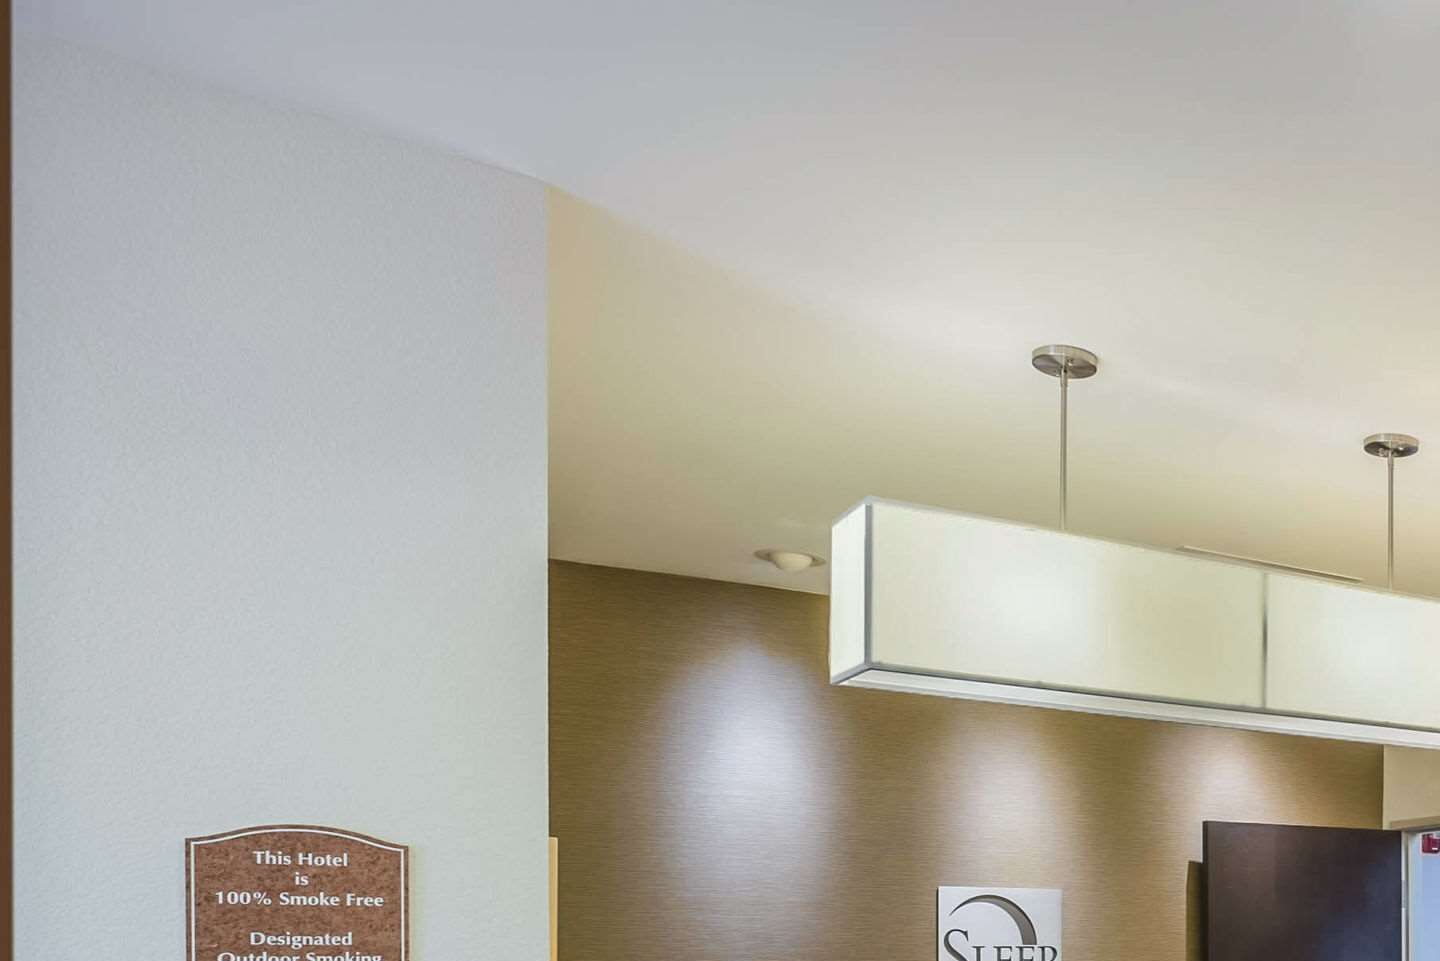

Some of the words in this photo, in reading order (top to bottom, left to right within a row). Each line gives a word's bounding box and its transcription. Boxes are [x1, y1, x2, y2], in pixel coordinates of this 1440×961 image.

[253, 851, 291, 865] This
[299, 853, 348, 866] Hotel
[295, 872, 309, 886] is
[215, 892, 272, 905] 100%
[279, 892, 340, 906] Smoke
[346, 893, 384, 907] Free
[250, 932, 353, 949] Designated
